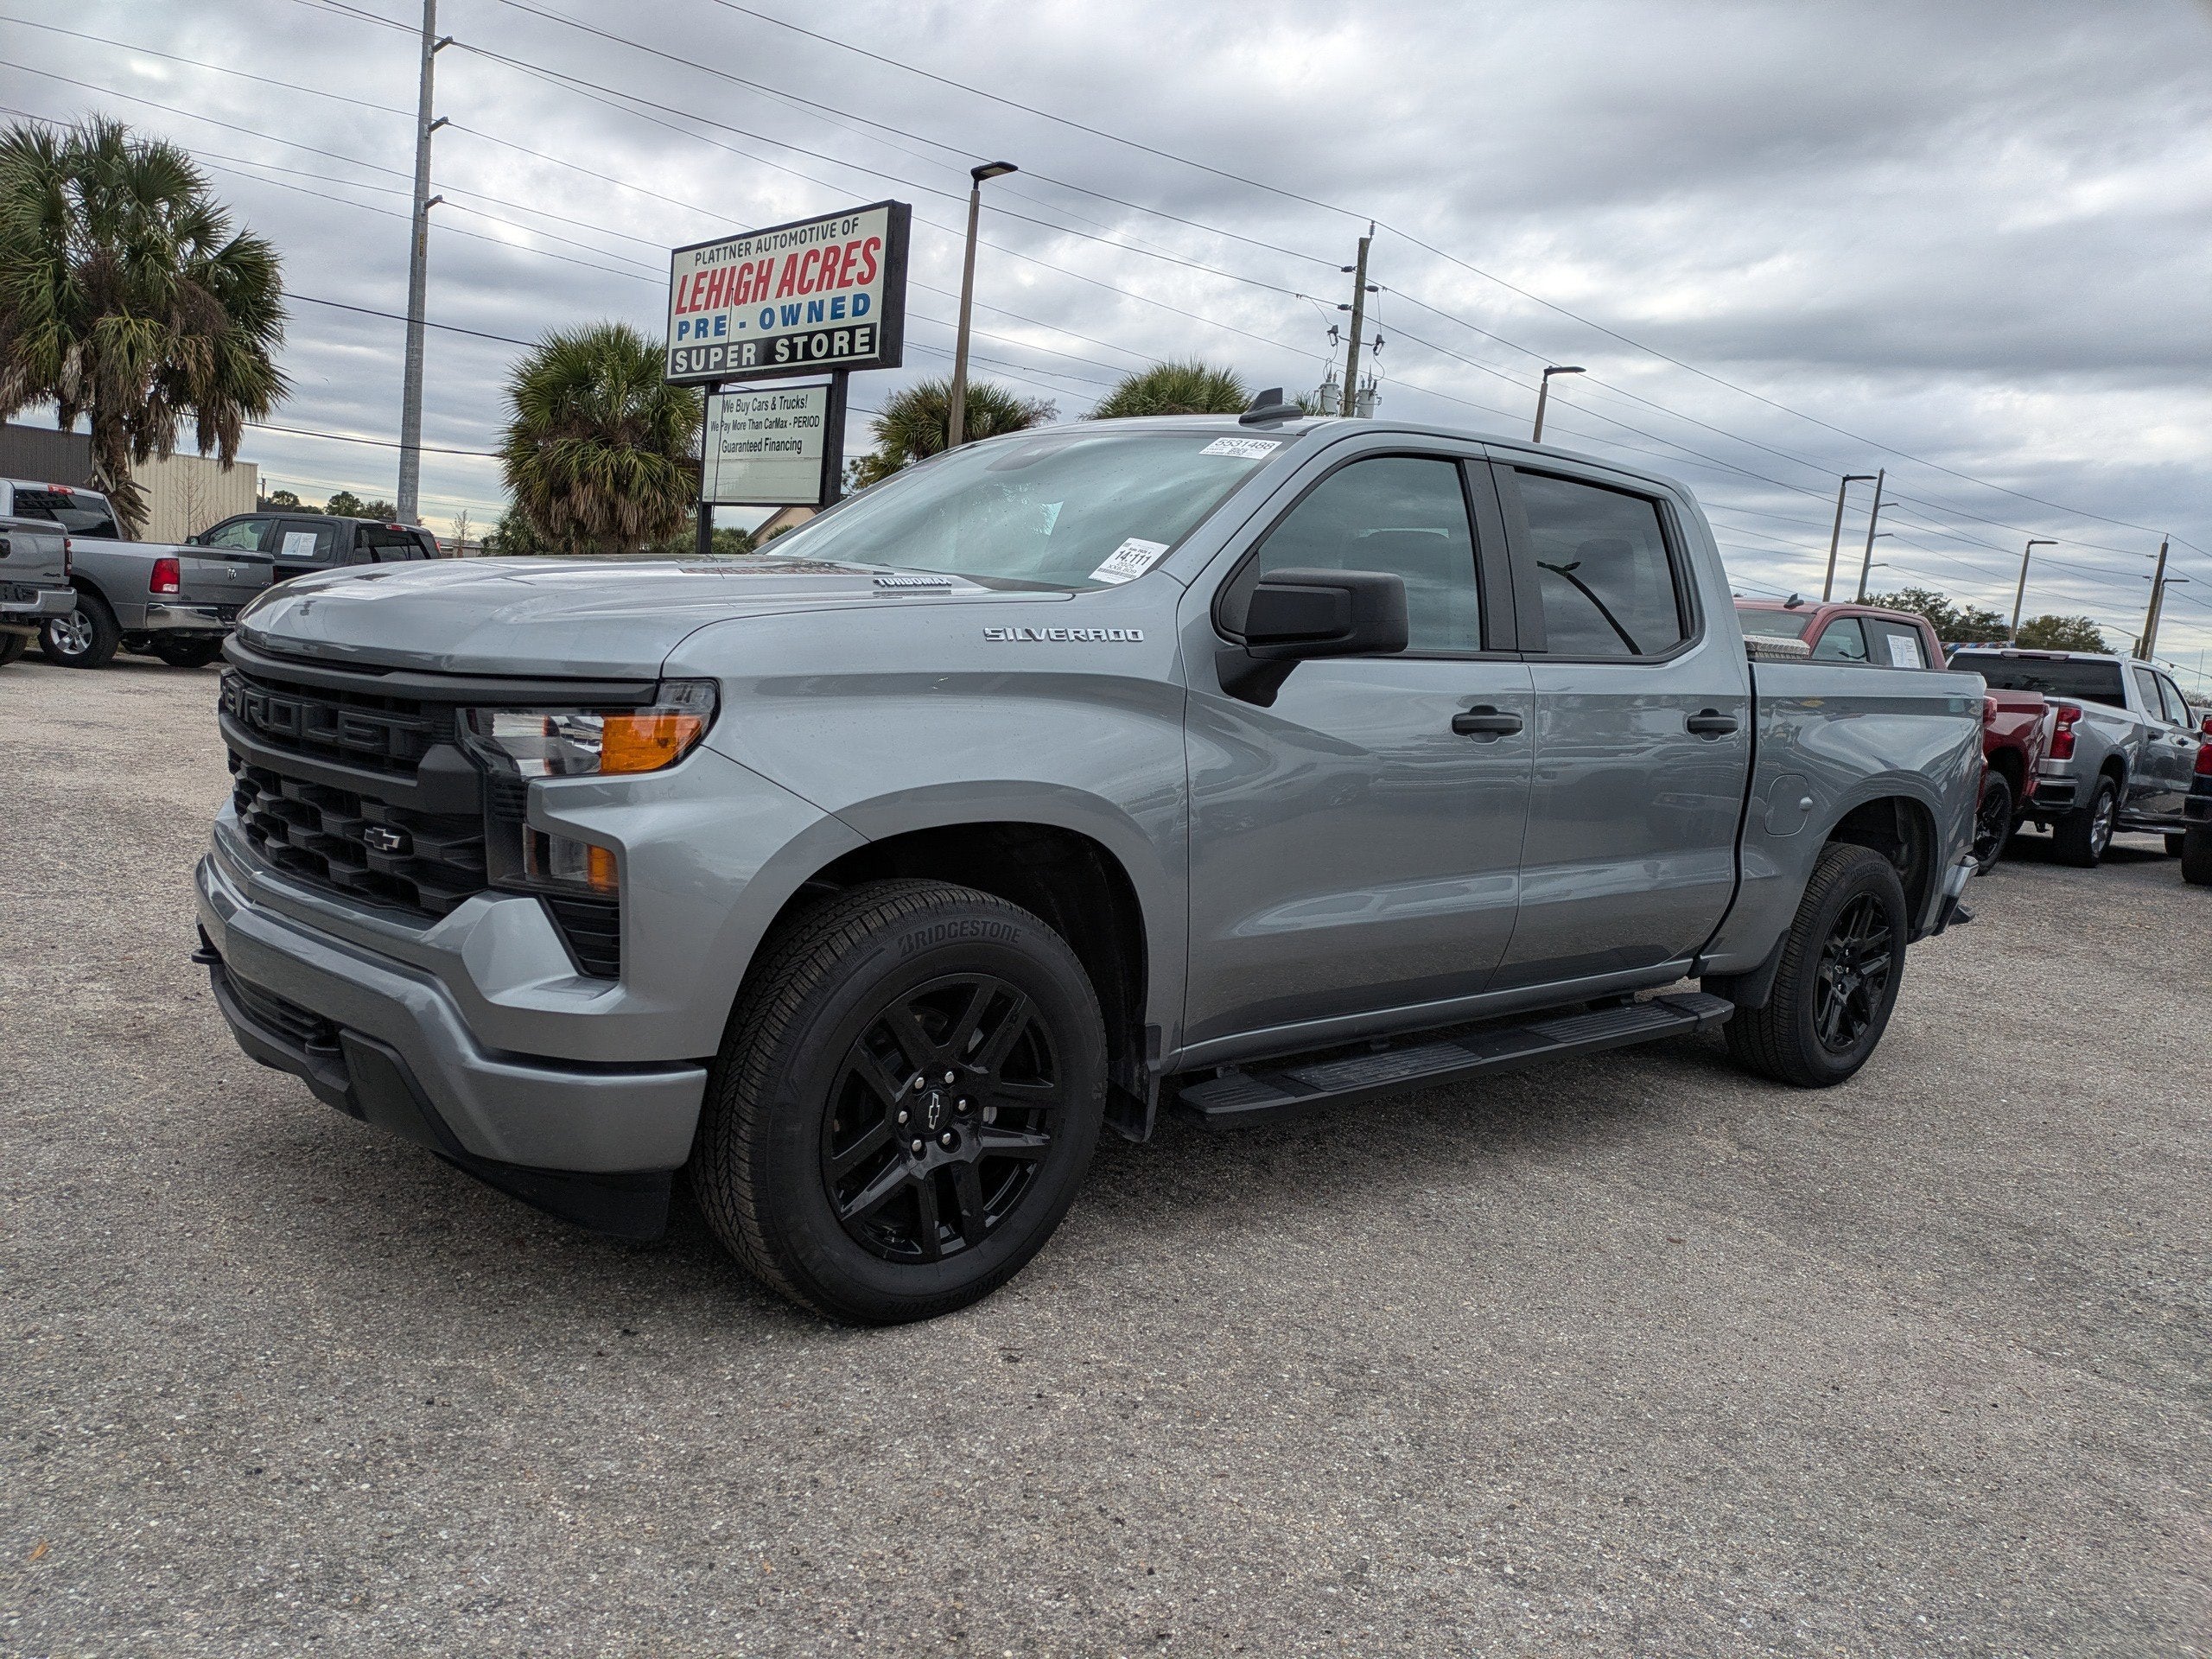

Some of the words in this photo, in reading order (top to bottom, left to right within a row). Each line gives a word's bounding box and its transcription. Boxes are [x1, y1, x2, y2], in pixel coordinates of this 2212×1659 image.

[695, 241, 752, 267] PLATTNER
[755, 221, 837, 254] AUTOMOTIVE
[842, 217, 860, 236] OF
[675, 257, 776, 316] LEHIGH
[775, 236, 881, 300] ACRES
[677, 315, 728, 342] PRE
[759, 292, 871, 331] OWNED
[675, 342, 757, 372] SUPER
[774, 327, 871, 363] STORE
[722, 399, 734, 413] We
[735, 398, 751, 416] Buy
[752, 397, 769, 412] Cars
[770, 396, 777, 410] &
[779, 394, 809, 410] Trucks!
[710, 421, 719, 432] We
[721, 420, 731, 434] Pay
[732, 419, 747, 431] More
[748, 418, 763, 430] Than
[764, 417, 788, 429] CarMax
[793, 415, 820, 429] PERIOD
[721, 437, 763, 454] Guaranteed
[764, 436, 803, 454] Financing
[1215, 439, 1275, 450] 5531488
[1116, 550, 1152, 566] 14:111
[873, 577, 952, 588] TURBOMAX
[983, 627, 1145, 642] SILVERADO
[897, 919, 1022, 958] BRIDGESTONE
